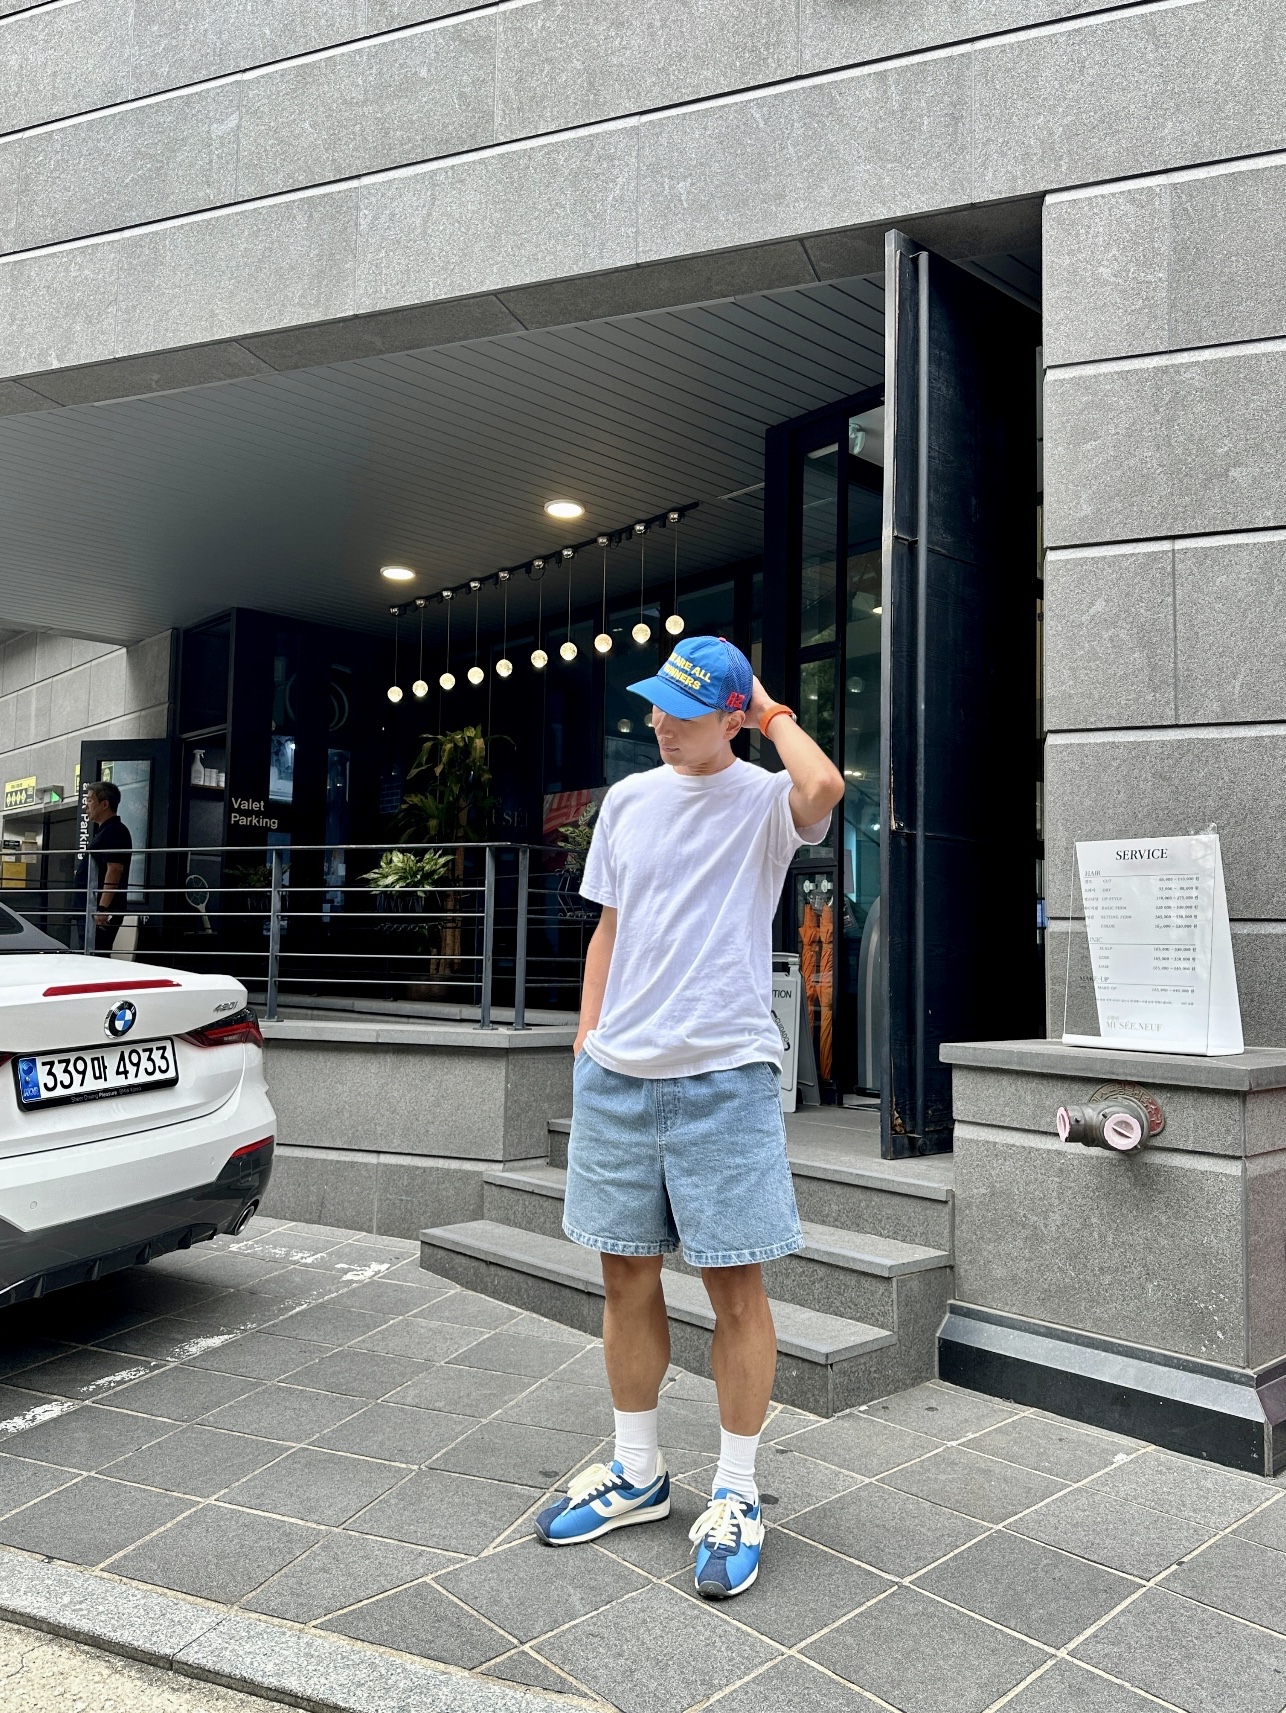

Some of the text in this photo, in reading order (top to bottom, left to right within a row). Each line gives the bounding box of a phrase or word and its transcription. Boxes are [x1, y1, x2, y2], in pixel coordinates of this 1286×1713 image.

[691, 666, 711, 683] ALL
[231, 797, 265, 811] Valet
[231, 813, 278, 829] Parking
[1116, 848, 1168, 861] SERVICE
[772, 989, 792, 999] TION
[213, 1001, 238, 1014] 420i
[775, 1017, 790, 1043] CUIDADO
[41, 1045, 170, 1093] 339마 4933
